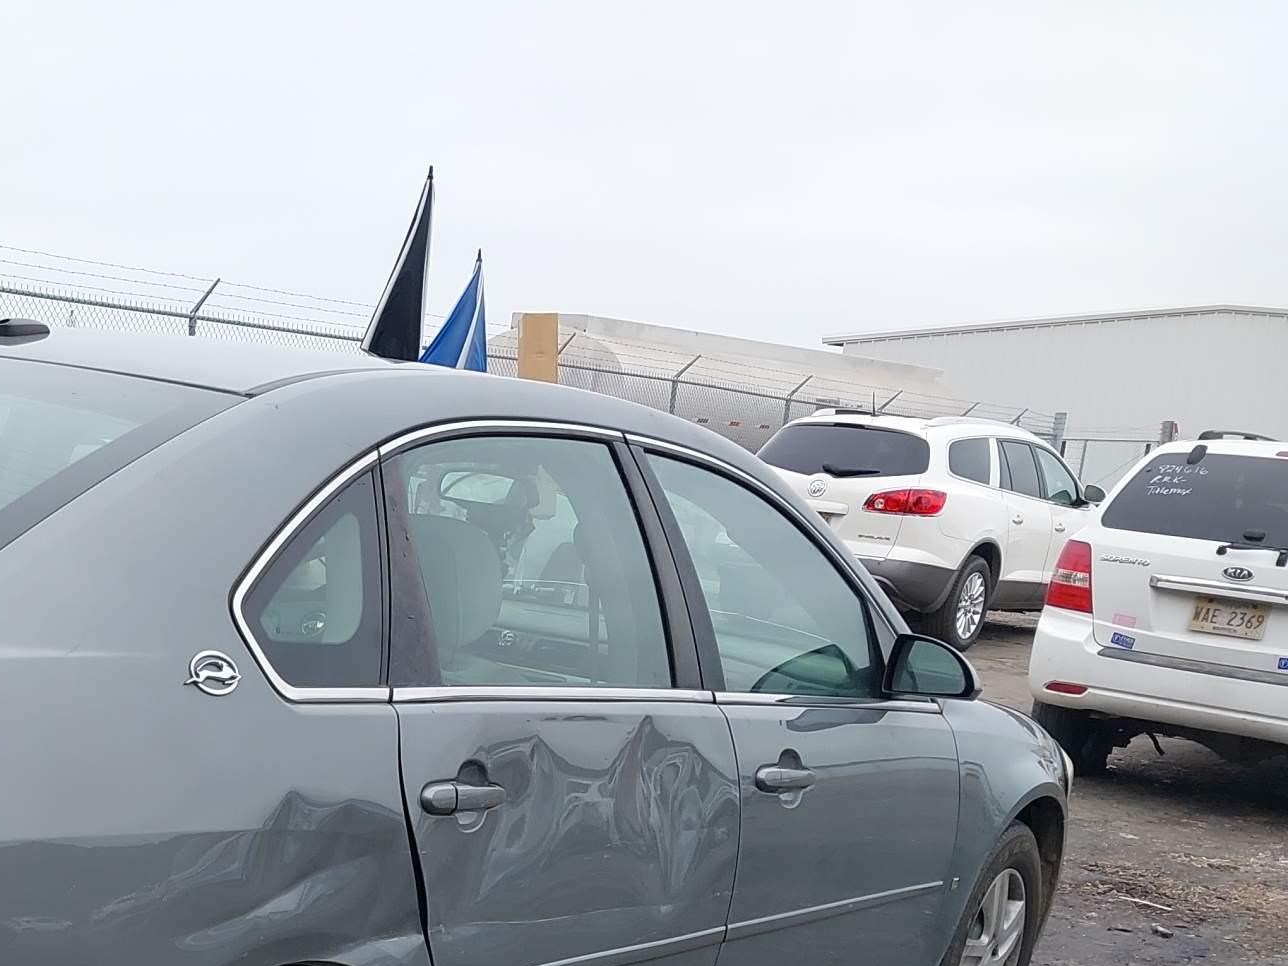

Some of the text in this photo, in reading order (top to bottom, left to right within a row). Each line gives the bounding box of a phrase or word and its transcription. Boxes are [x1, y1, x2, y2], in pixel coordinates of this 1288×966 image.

[1226, 568, 1250, 578] KIA
[1192, 606, 1265, 630] WAE 2369
